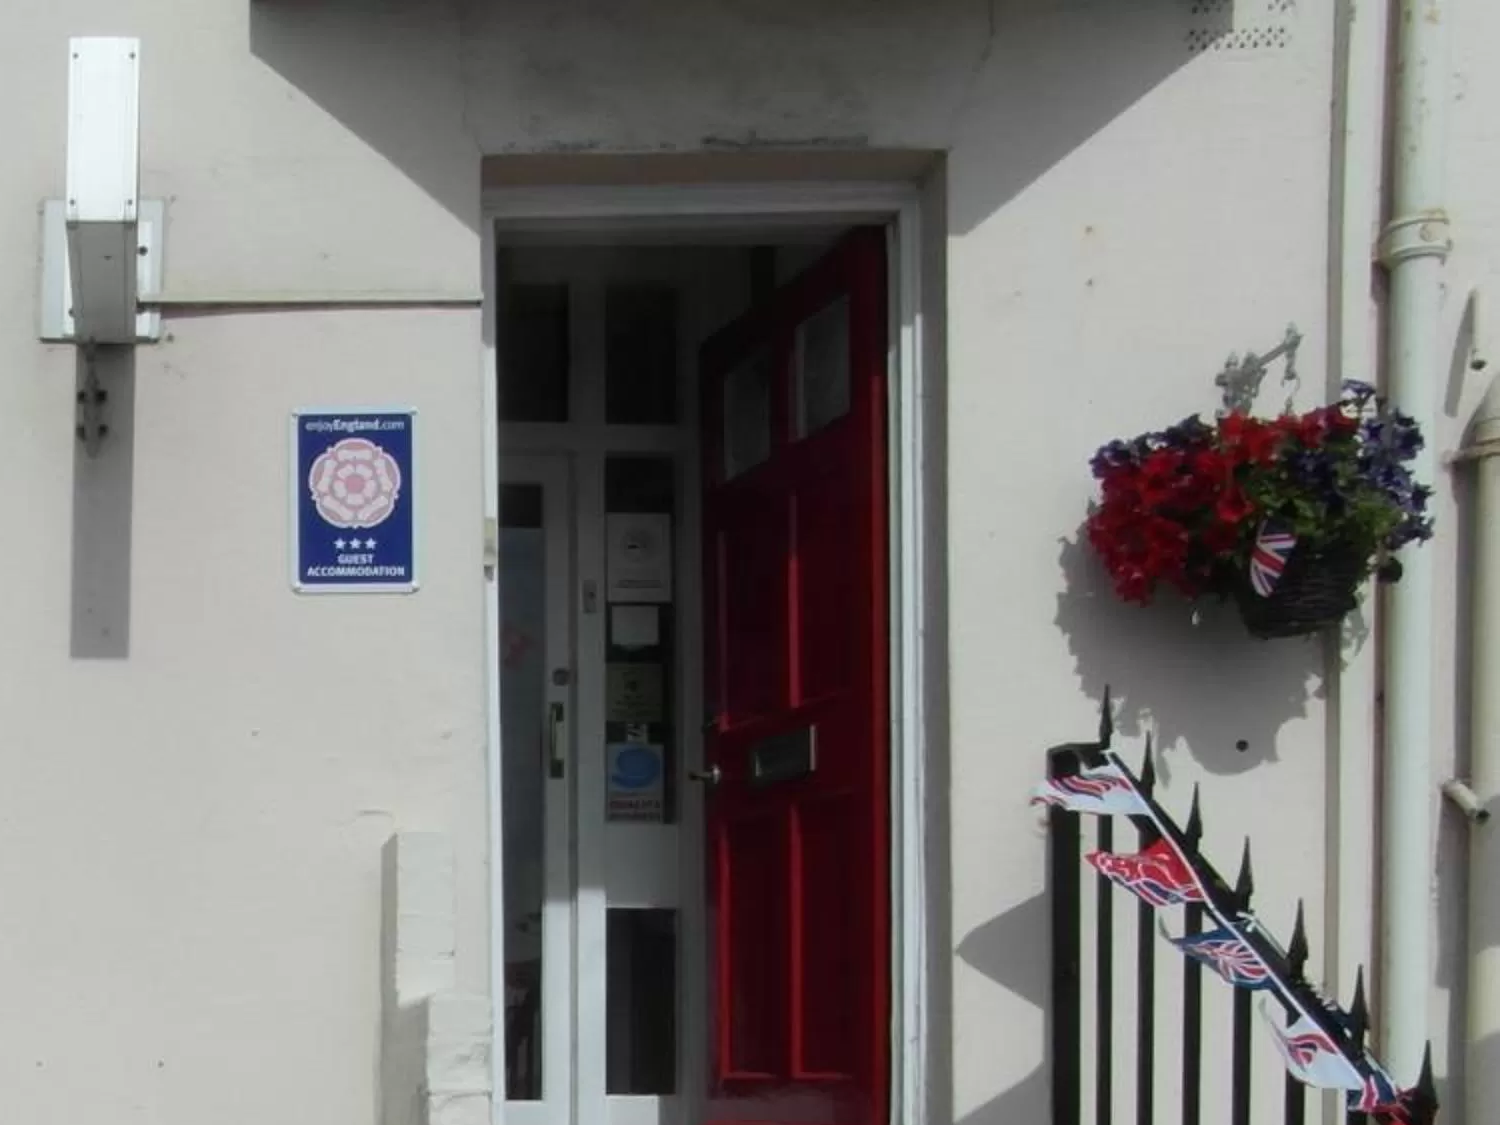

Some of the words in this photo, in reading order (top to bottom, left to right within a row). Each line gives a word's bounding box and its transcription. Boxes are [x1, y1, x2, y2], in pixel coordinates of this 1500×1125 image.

[305, 419, 405, 432] enjoyEngland.com
[338, 554, 375, 565] GUEST
[307, 566, 405, 577] ACCOMMODATION
